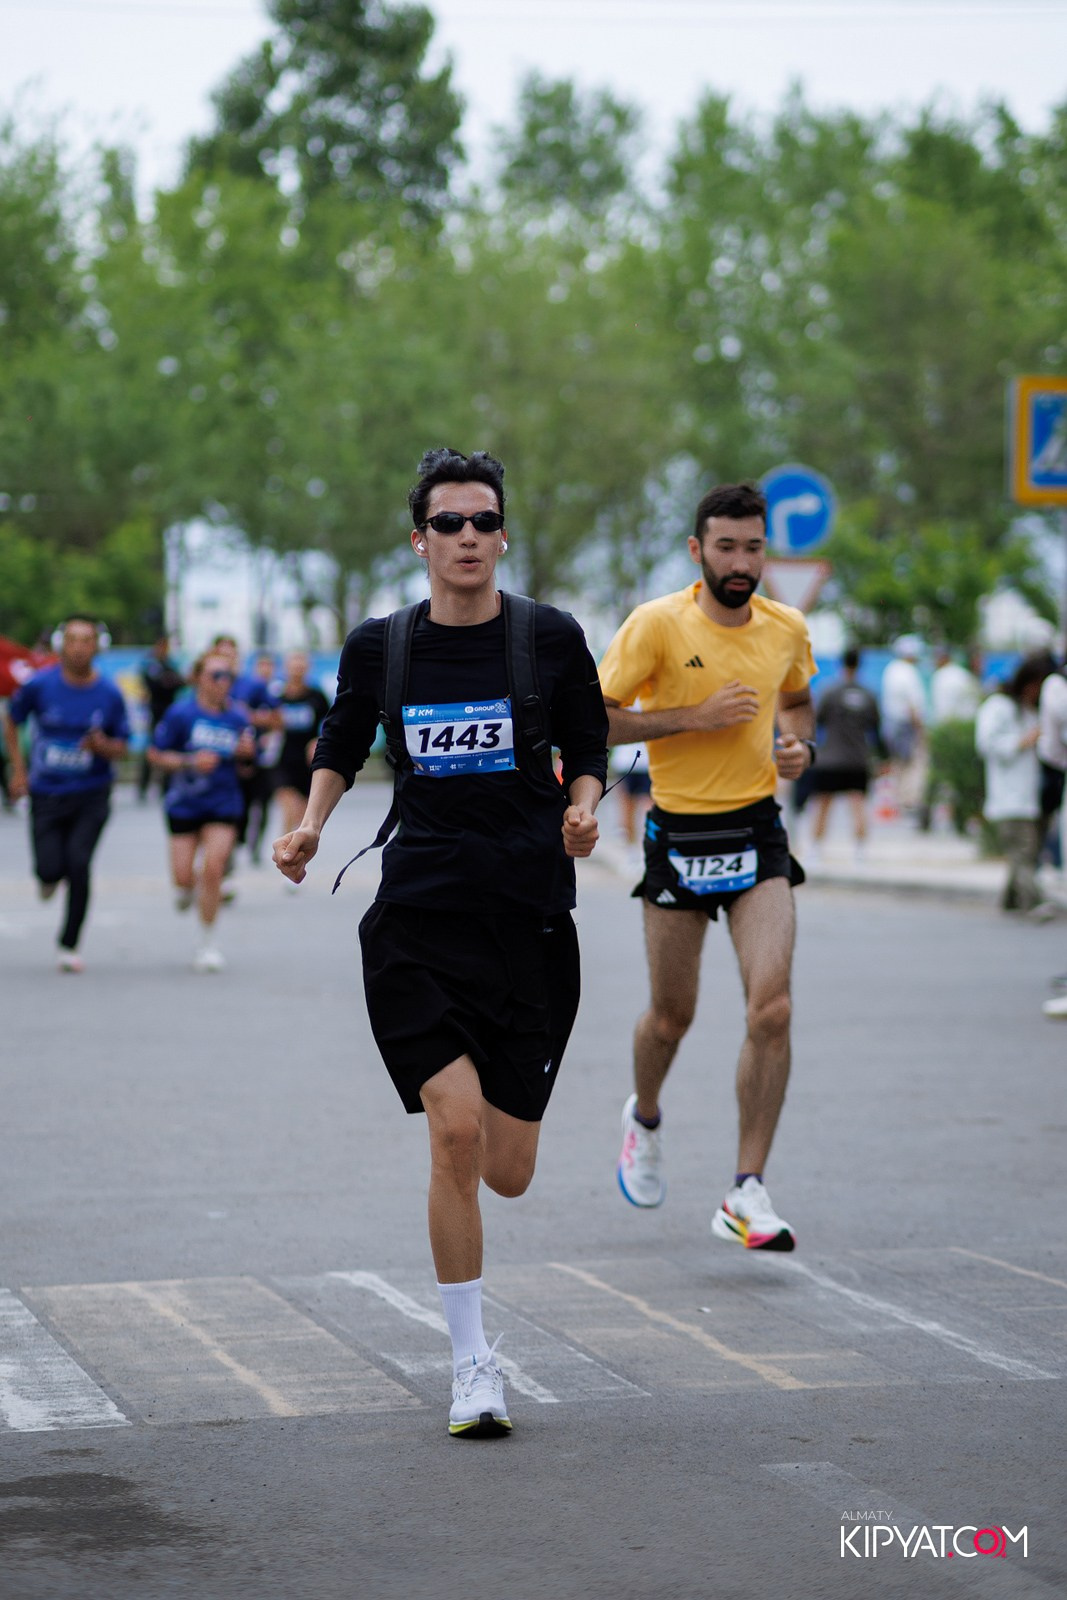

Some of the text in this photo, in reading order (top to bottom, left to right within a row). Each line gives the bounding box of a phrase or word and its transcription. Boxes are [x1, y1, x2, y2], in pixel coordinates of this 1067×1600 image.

[407, 708, 434, 717] 5 KM
[418, 722, 503, 754] 1443
[684, 855, 743, 877] 1124
